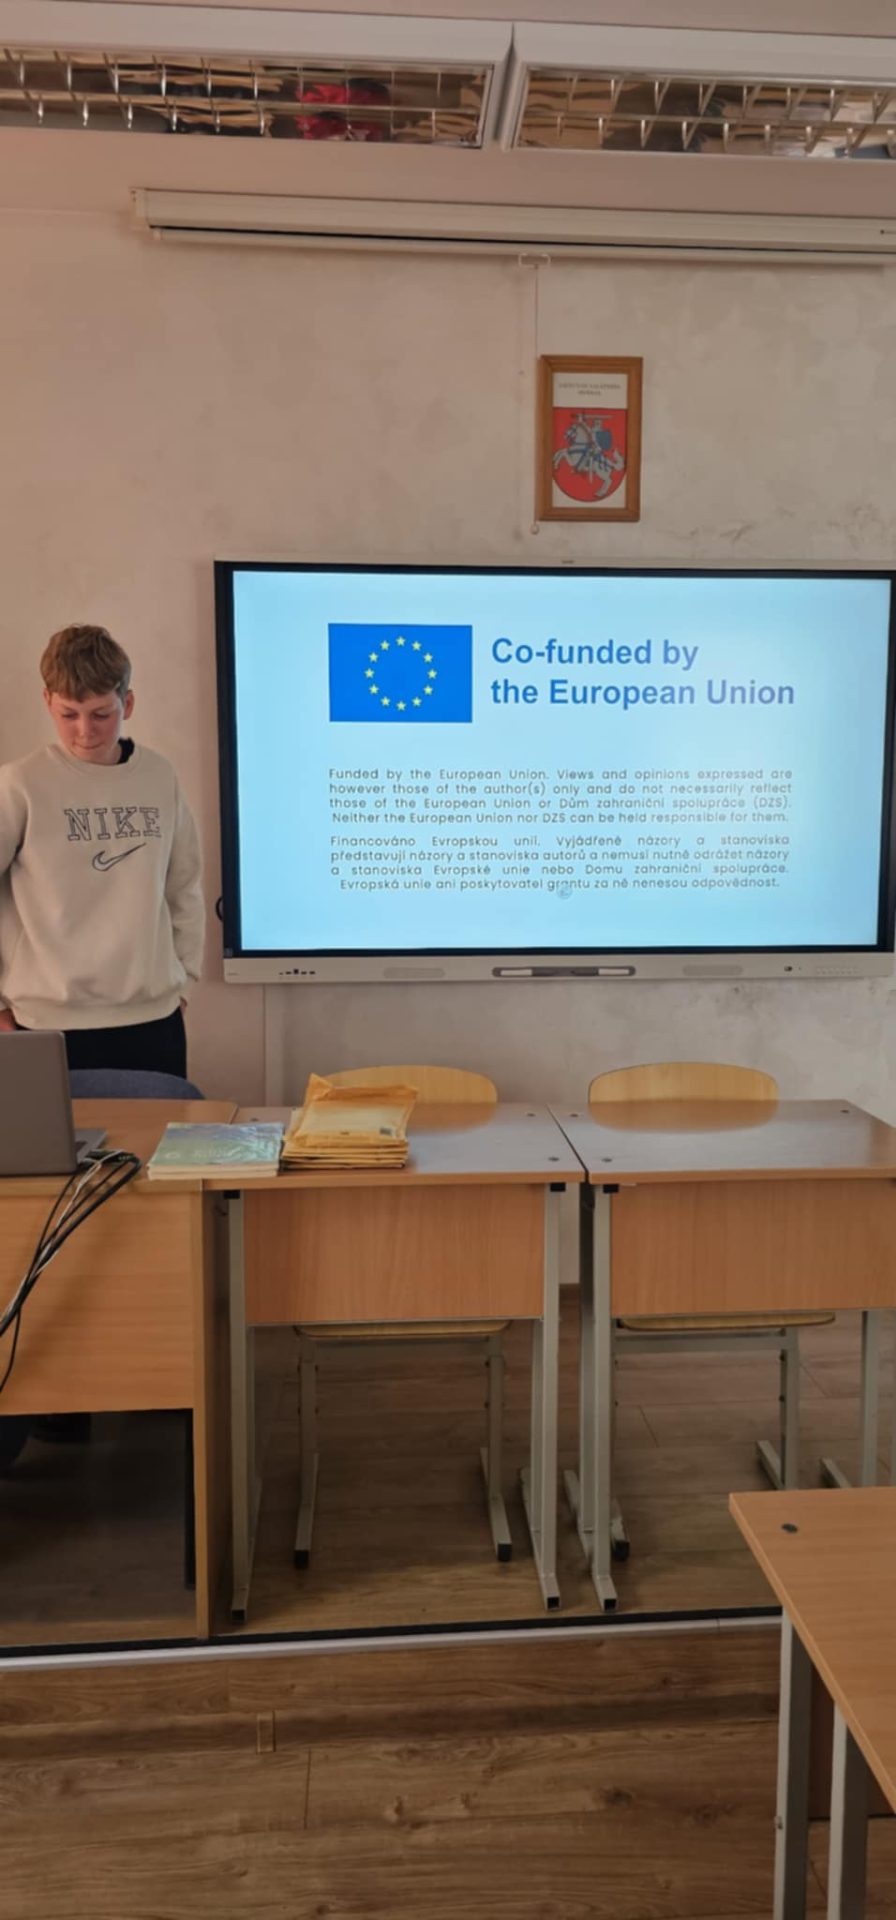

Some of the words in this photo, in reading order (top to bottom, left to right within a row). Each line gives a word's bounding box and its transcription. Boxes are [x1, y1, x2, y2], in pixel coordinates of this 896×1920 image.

[491, 637, 652, 665] Co-funded
[662, 639, 699, 671] by
[491, 678, 538, 704] the
[549, 678, 695, 710] European
[707, 679, 795, 705] Union
[329, 768, 378, 780] Funded
[387, 768, 402, 782] by
[410, 768, 431, 780] the
[440, 768, 501, 782] European
[509, 768, 549, 780] Union.
[557, 767, 594, 779] Views
[602, 767, 627, 779] and
[635, 767, 689, 781] opinions
[698, 767, 763, 781] expressed
[771, 770, 792, 779] are
[330, 782, 385, 794] however
[393, 782, 429, 794] those
[436, 782, 448, 794] of
[456, 782, 476, 794] the
[484, 782, 545, 796] author(s)
[553, 782, 579, 796] only
[587, 782, 611, 794] and
[619, 782, 635, 794] do
[643, 782, 662, 794] not
[671, 782, 743, 796] necessarily
[751, 782, 791, 794] reflect
[330, 797, 366, 809] those
[375, 797, 387, 809] of
[395, 797, 416, 809] the
[424, 797, 486, 811] European
[494, 797, 530, 809] Union
[538, 800, 551, 809] or
[560, 796, 589, 808] Dům
[597, 796, 664, 808] zahraniční
[673, 796, 744, 810] spolupráce
[754, 796, 791, 810] (DZS).
[63, 805, 162, 841] NIKE
[333, 811, 380, 823] Neither
[384, 811, 405, 823] the
[410, 811, 472, 825] European
[476, 811, 513, 823] Union
[517, 814, 538, 823] nor
[542, 811, 565, 823] DZS
[570, 814, 594, 823] can
[599, 811, 615, 823] be
[619, 811, 646, 823] held
[651, 811, 726, 825] responsible
[731, 811, 747, 823] for
[752, 811, 788, 823] them.
[331, 835, 416, 847] Financováno
[432, 834, 498, 848] Evropskou
[556, 834, 622, 848] Vyjádřené
[638, 834, 680, 848] názory
[696, 836, 704, 845] a
[721, 833, 789, 845] stanoviska
[331, 849, 405, 863] představují
[410, 849, 453, 863] názory
[457, 852, 465, 861] a
[470, 849, 539, 861] stanoviska
[543, 848, 585, 860] autorů
[590, 851, 597, 860] a
[602, 848, 648, 860] nemusí
[653, 848, 689, 860] nutně
[694, 848, 742, 860] odrážet
[747, 848, 789, 862] názory
[331, 867, 339, 876] a
[352, 864, 422, 876] stanoviska
[434, 863, 491, 877] Evropské
[502, 863, 530, 875] unie
[542, 863, 574, 875] nebo
[585, 863, 622, 875] Domu
[635, 863, 701, 875] zahraniční
[341, 878, 399, 892] Evropská
[404, 878, 431, 890] unie
[436, 877, 455, 889] ani
[460, 877, 542, 891] poskytovatel
[594, 880, 608, 889] za
[613, 876, 628, 888] ně
[633, 879, 687, 888] nenesou
